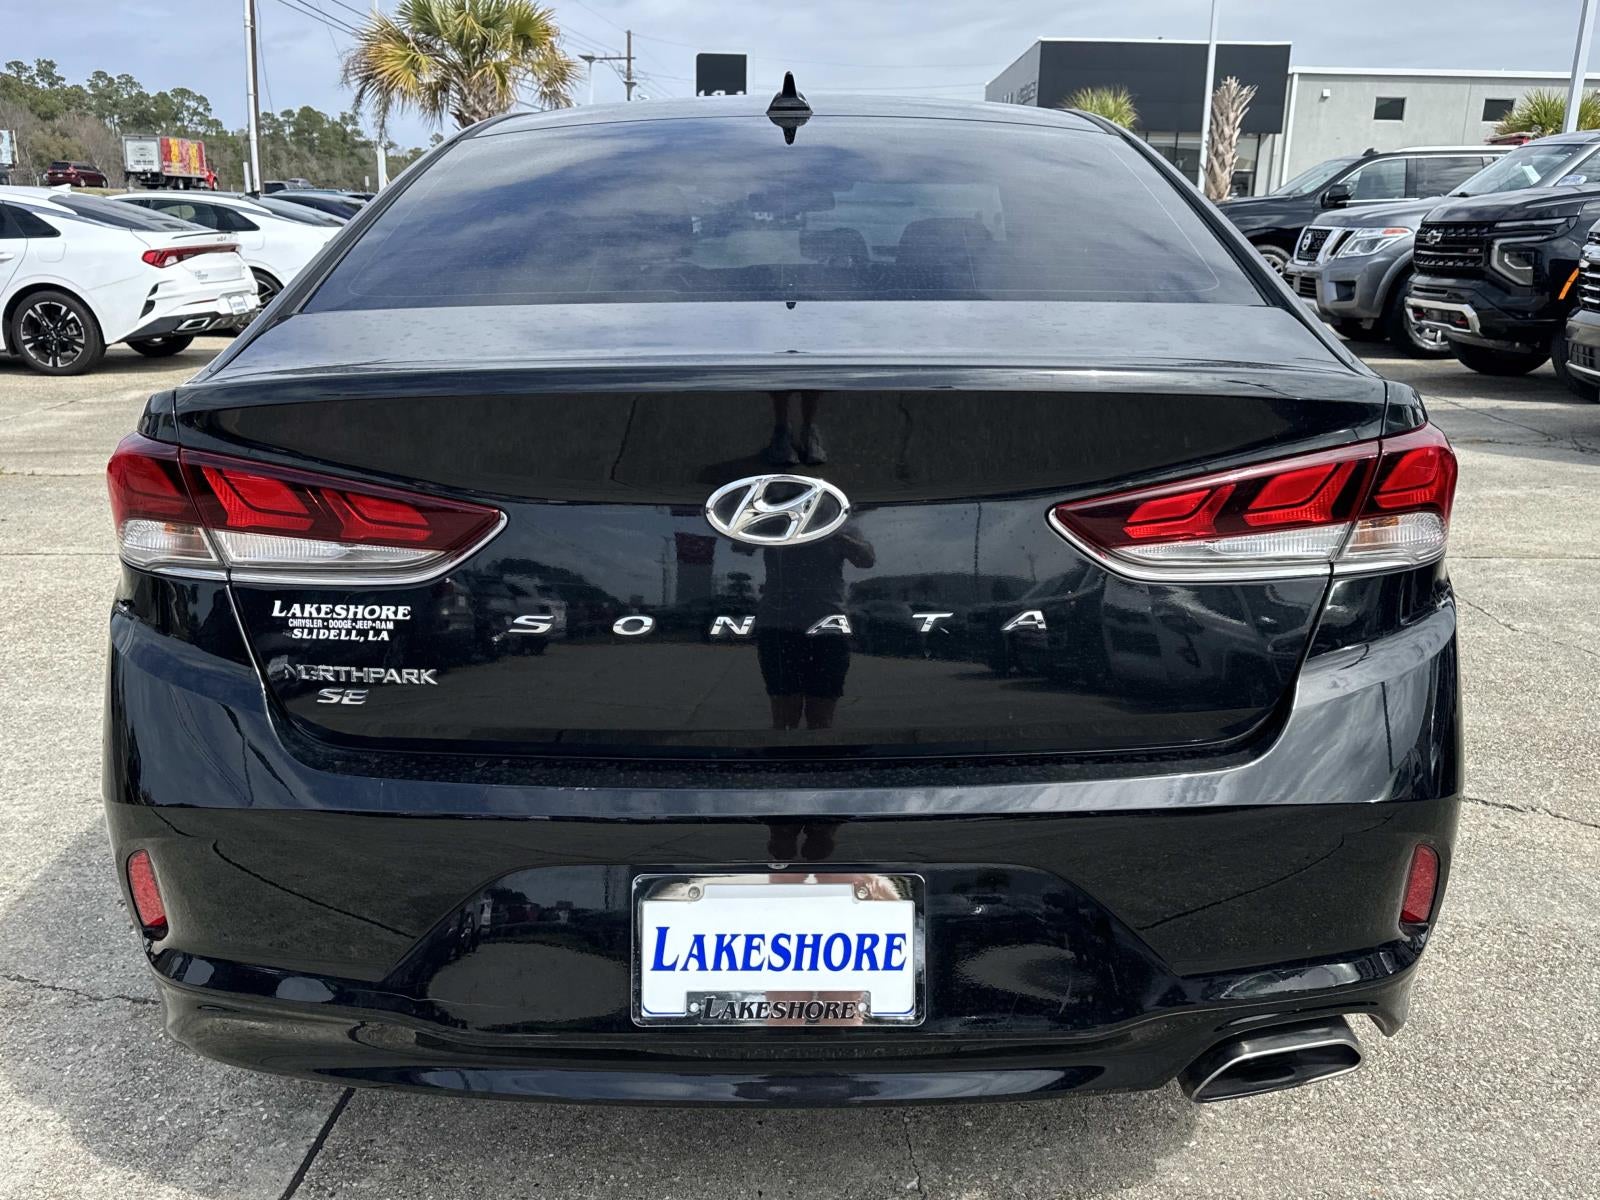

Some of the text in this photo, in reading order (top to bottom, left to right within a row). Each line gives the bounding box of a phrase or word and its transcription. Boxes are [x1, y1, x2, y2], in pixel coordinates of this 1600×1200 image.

[272, 600, 411, 620] LAKESHORE
[288, 618, 323, 628] CHRYSLER
[508, 610, 1047, 635] SONATA
[291, 628, 390, 642] SLIDELL, LA
[316, 688, 369, 705] SE
[650, 926, 907, 972] LAKESHORE
[701, 997, 858, 1020] LAKESHORE
